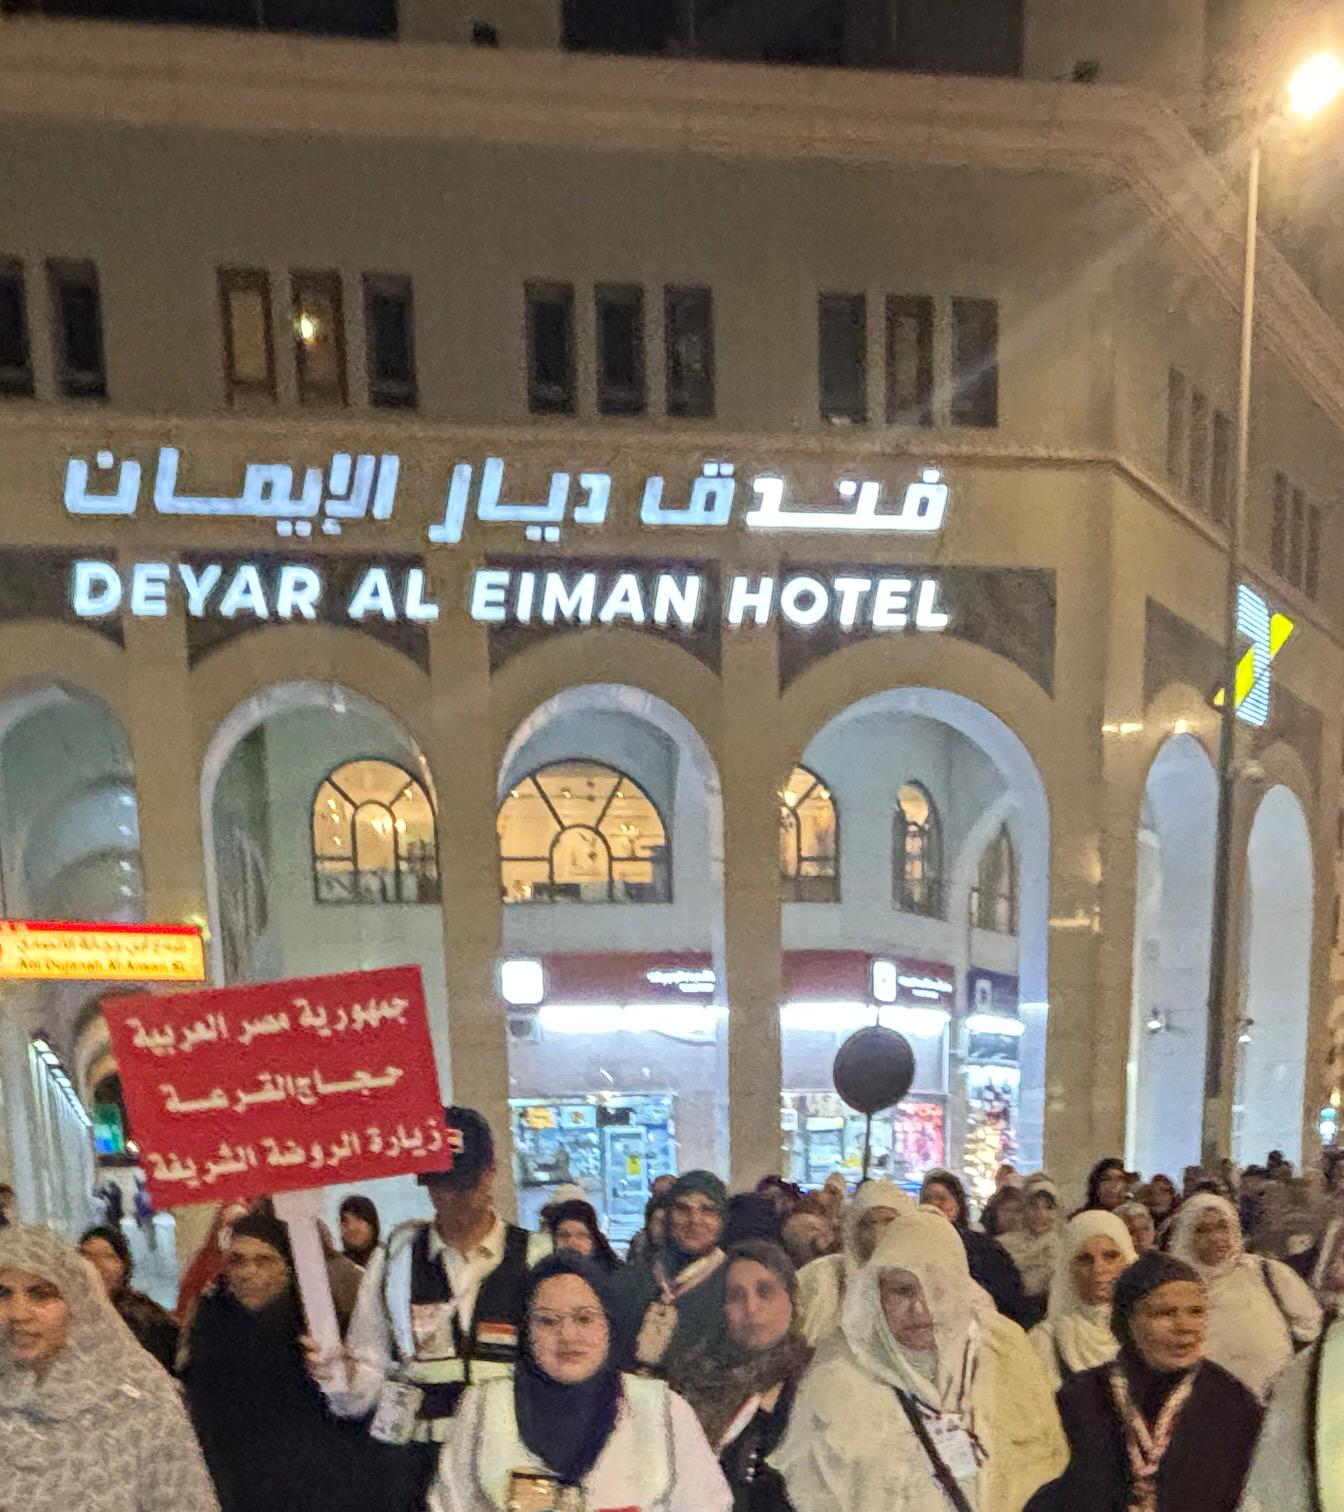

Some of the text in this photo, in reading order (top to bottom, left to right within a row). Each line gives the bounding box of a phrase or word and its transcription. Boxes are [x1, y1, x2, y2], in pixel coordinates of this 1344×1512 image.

[64, 447, 951, 544] فندق ديار الإيمان
[72, 561, 952, 632] DEYAR AL EIMAN HOTEL
[126, 997, 409, 1056] جمهورية مصر العربية
[159, 1072, 296, 1113] القرعة
[147, 1143, 258, 1188] الشريفة
[261, 1132, 360, 1168] الروضة
